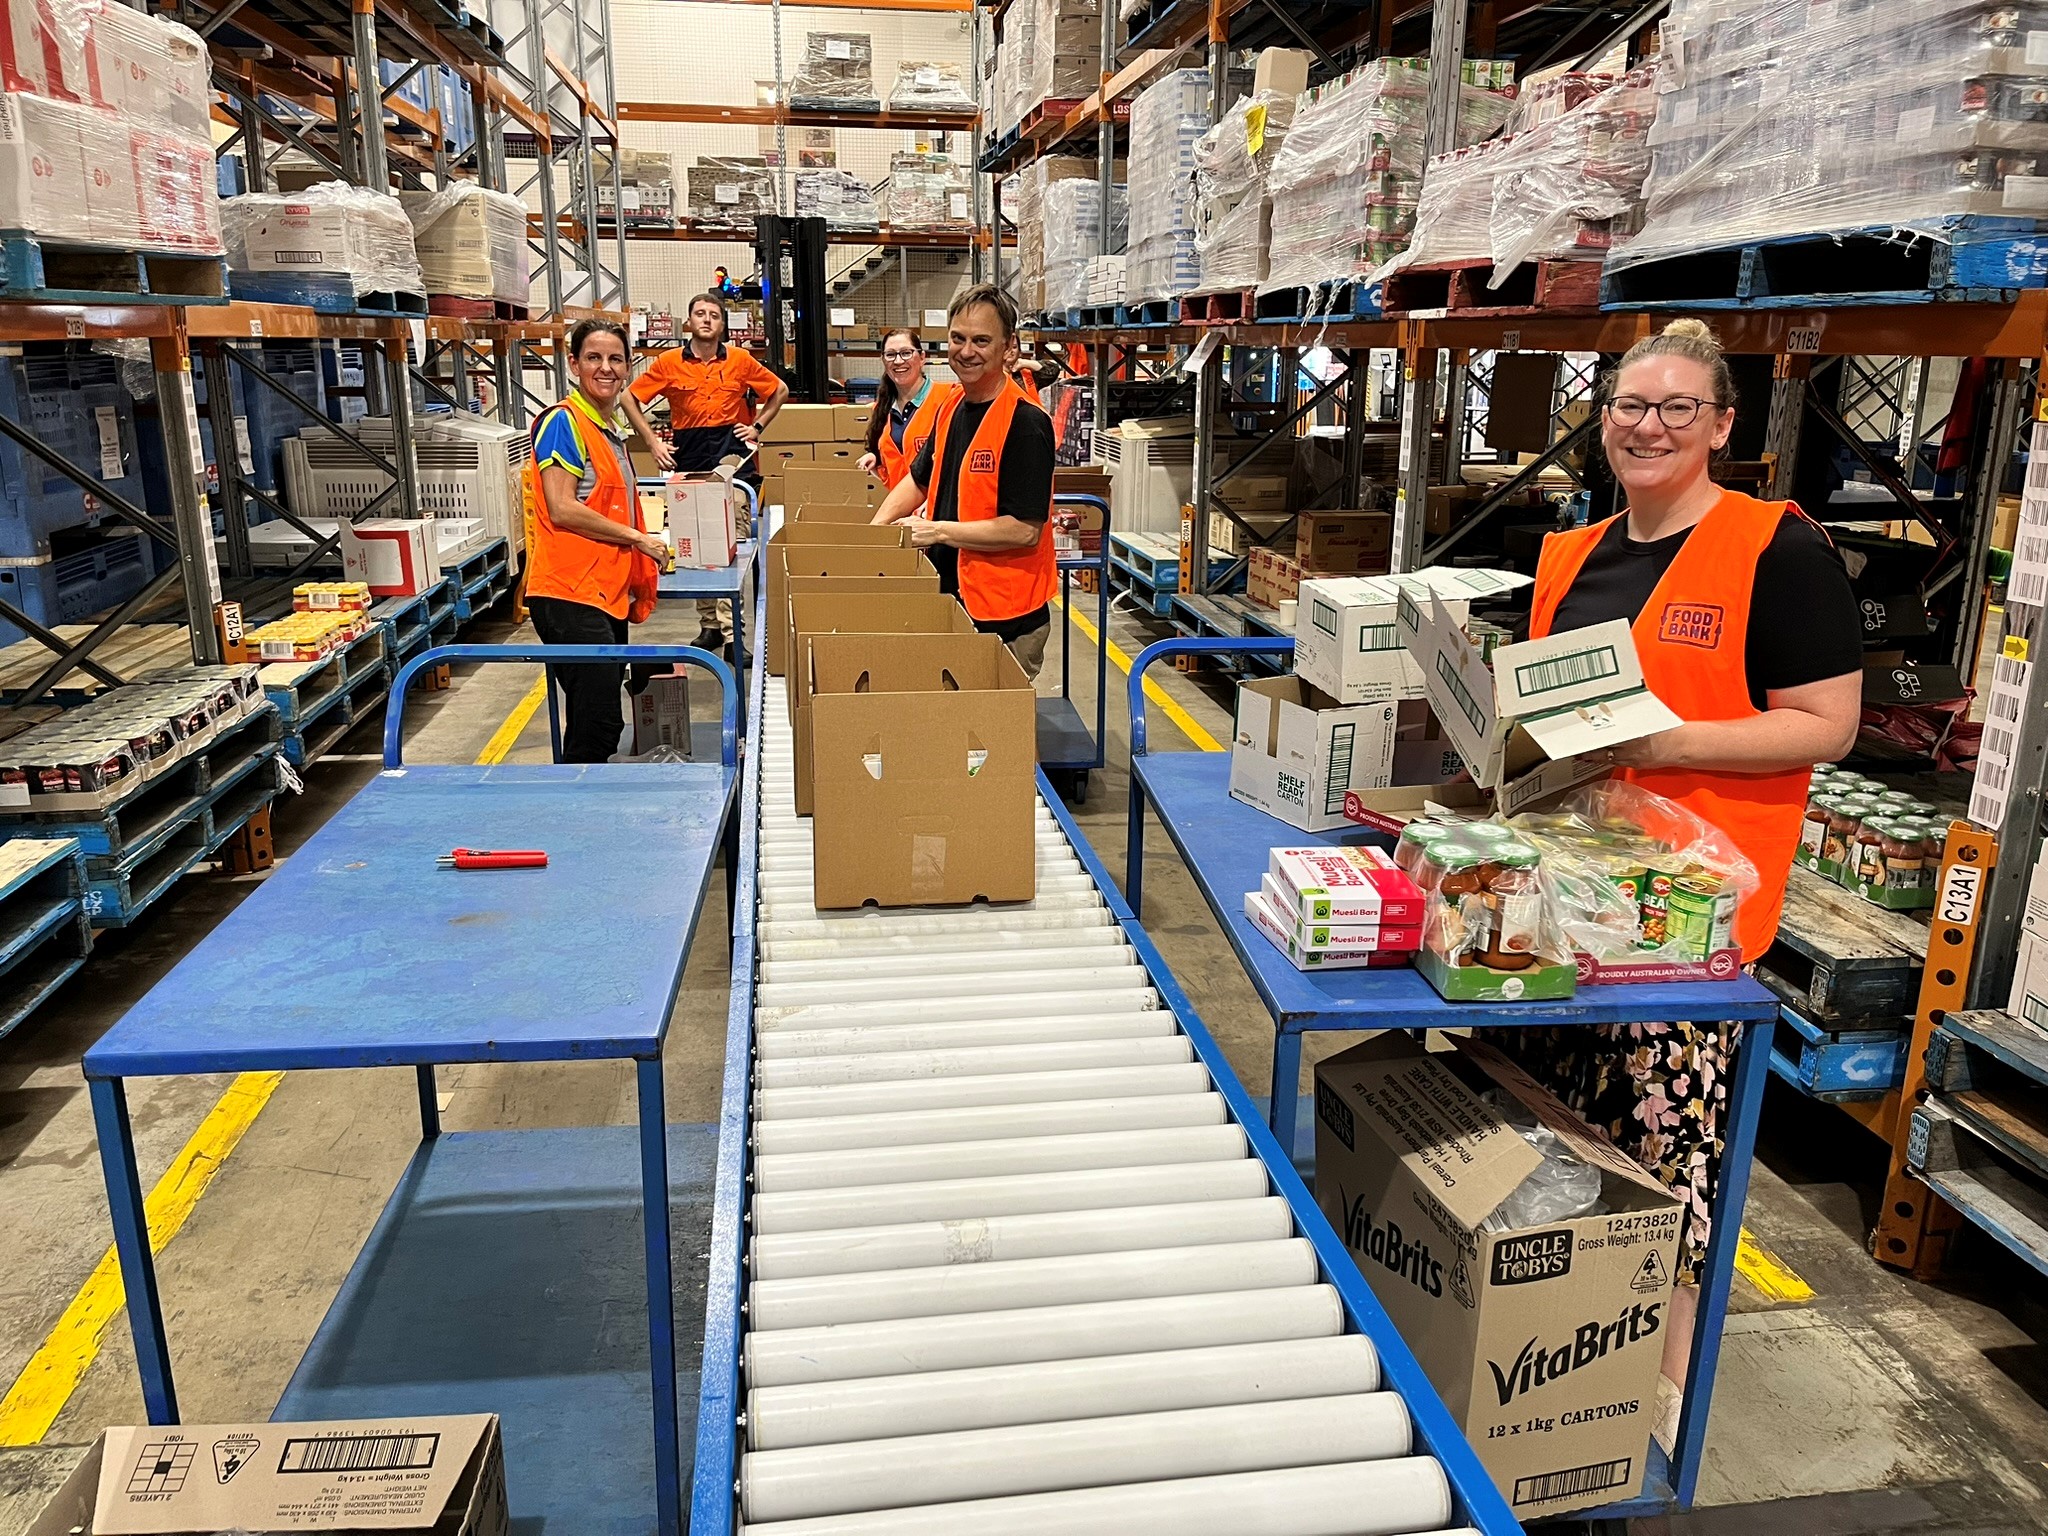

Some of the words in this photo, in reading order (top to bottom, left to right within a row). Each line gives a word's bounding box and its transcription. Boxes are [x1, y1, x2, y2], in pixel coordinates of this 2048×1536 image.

[1112, 104, 1130, 114] LOS
[1787, 330, 1820, 351] C11B2
[1182, 521, 1190, 542] C09A1
[229, 604, 242, 640] C12A1
[1671, 610, 1713, 626] FOOD
[1668, 623, 1710, 641] BANK
[1441, 759, 1464, 769] REA
[1277, 780, 1305, 798] READY
[1278, 771, 1306, 787] SHELF
[1276, 790, 1304, 808] CARTON
[1359, 812, 1379, 825] PROUDLY
[1306, 856, 1348, 887] Muesli
[1341, 868, 1365, 886] Bars
[1653, 881, 1671, 892] spc
[1944, 866, 1976, 922] C13A1
[1332, 908, 1358, 917] Muesli
[1360, 907, 1378, 916] Bars
[1330, 935, 1357, 943] Muesli
[1358, 935, 1376, 943] Bars
[1323, 952, 1348, 960] Muesli
[1349, 951, 1367, 959] Bars
[1712, 961, 1732, 971] spc
[1630, 969, 1675, 978] AUSTRALIAN
[1677, 968, 1706, 976] OWNED
[1383, 1074, 1410, 1102] Australia
[1408, 1066, 1433, 1089] CARE
[1319, 1083, 1350, 1123] UNCLE
[1429, 1087, 1452, 1111] WITH
[1321, 1105, 1352, 1146] TOBYS
[1375, 1104, 1406, 1135] Australia
[1428, 1117, 1445, 1137] NSW
[1448, 1107, 1488, 1142] HANDLE
[1482, 1111, 1502, 1135] Store
[1402, 1132, 1431, 1164] Partners
[1408, 1120, 1445, 1159] Homebush
[1444, 1134, 1474, 1164] Rhodes
[1429, 1162, 1456, 1188] Cereal
[1606, 1212, 1678, 1233] 12473820
[1339, 1182, 1443, 1299] VitaBrits
[1500, 1234, 1566, 1262] UNCLE
[1578, 1237, 1604, 1251] Gross
[1607, 1231, 1641, 1248] Weight:
[1644, 1230, 1662, 1243] 13.4
[1663, 1228, 1674, 1242] kg
[1498, 1253, 1566, 1281] TOBYS
[1637, 1287, 1658, 1295] CAUTION
[1486, 1302, 1661, 1407] VitaBrits
[1487, 1425, 1506, 1439] 12
[1510, 1424, 1521, 1436] x
[1526, 1417, 1555, 1432] 1kg
[1560, 1400, 1639, 1426] CARTONS
[337, 1474, 348, 1483] kg
[350, 1474, 366, 1482] 13.4
[375, 1474, 404, 1482] Weight
[129, 1494, 167, 1502] LAYERS
